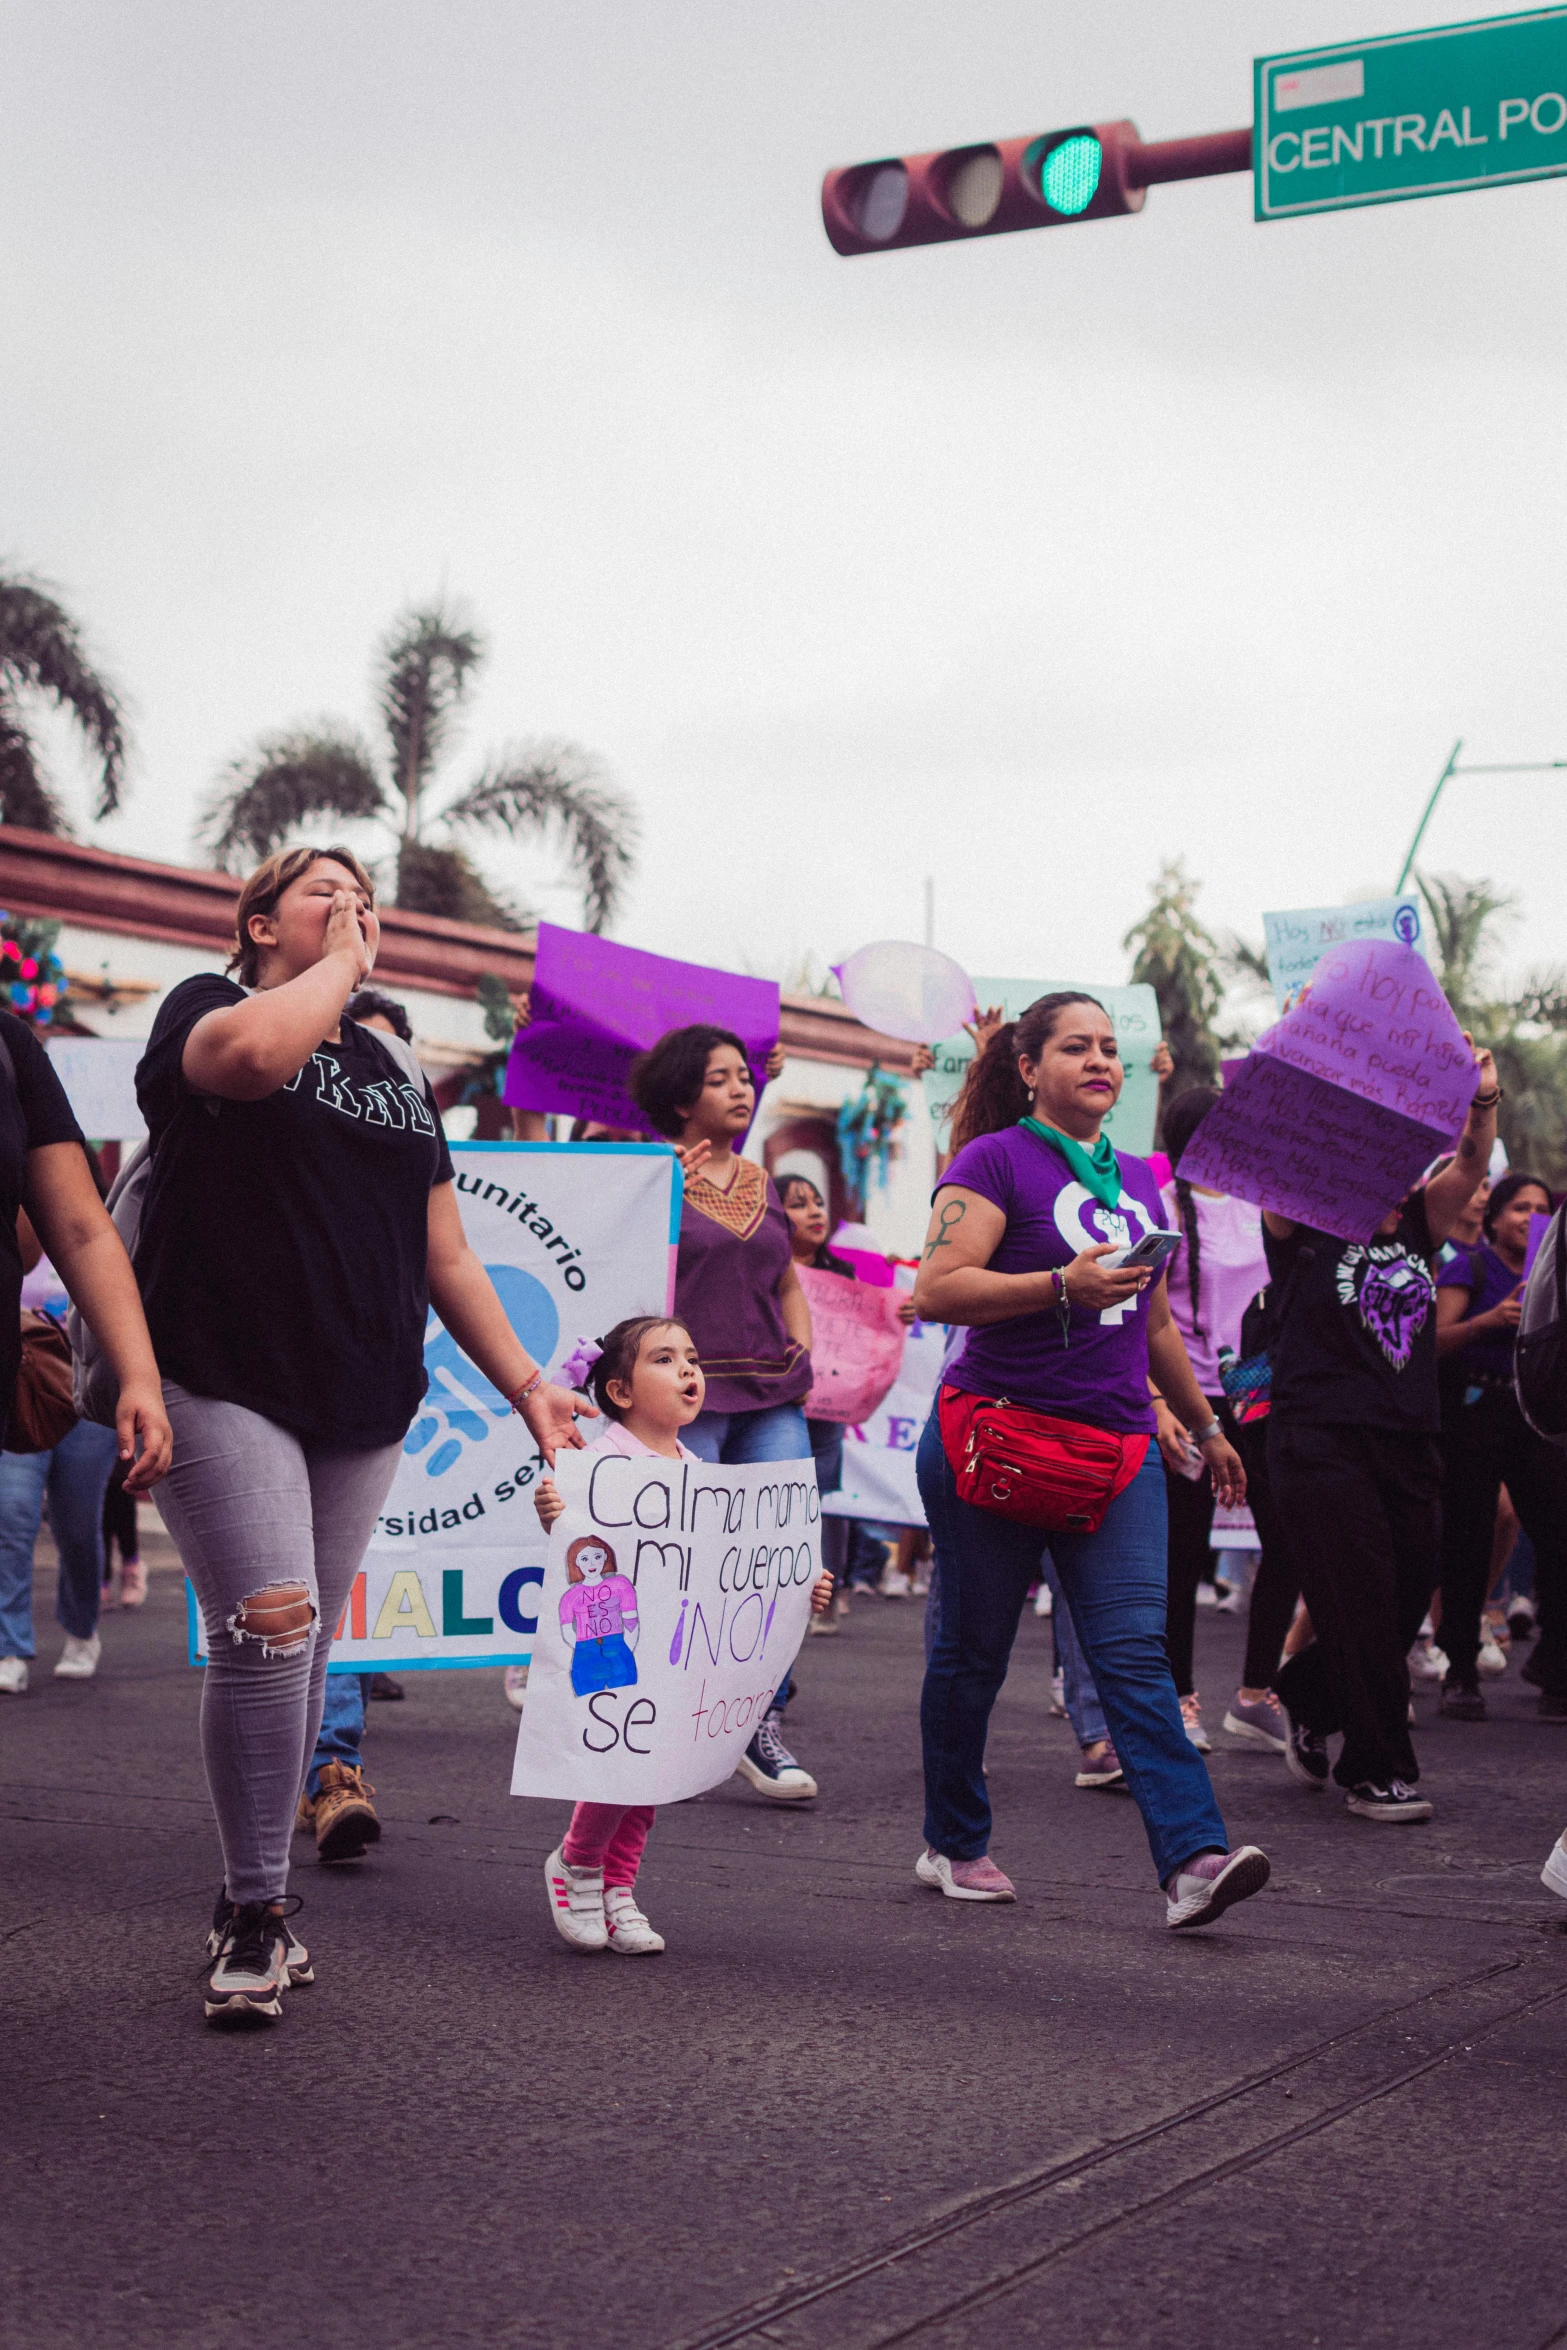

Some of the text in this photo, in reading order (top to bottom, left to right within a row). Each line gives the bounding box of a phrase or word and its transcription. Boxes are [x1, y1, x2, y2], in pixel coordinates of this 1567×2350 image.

[1268, 106, 1488, 173] CENTRAL
[1359, 952, 1406, 1015] hoy
[1334, 1010, 1373, 1037] que
[1387, 1029, 1420, 1047] mi
[1263, 1030, 1343, 1077] Avanzar
[1367, 1053, 1430, 1087] pueda
[589, 1454, 747, 1534] Calma
[633, 1538, 812, 1600] mi cuerpo
[582, 1585, 612, 1604] NO
[587, 1602, 609, 1619] ES
[585, 1618, 612, 1638] NO
[669, 1593, 776, 1671] ¡NO!
